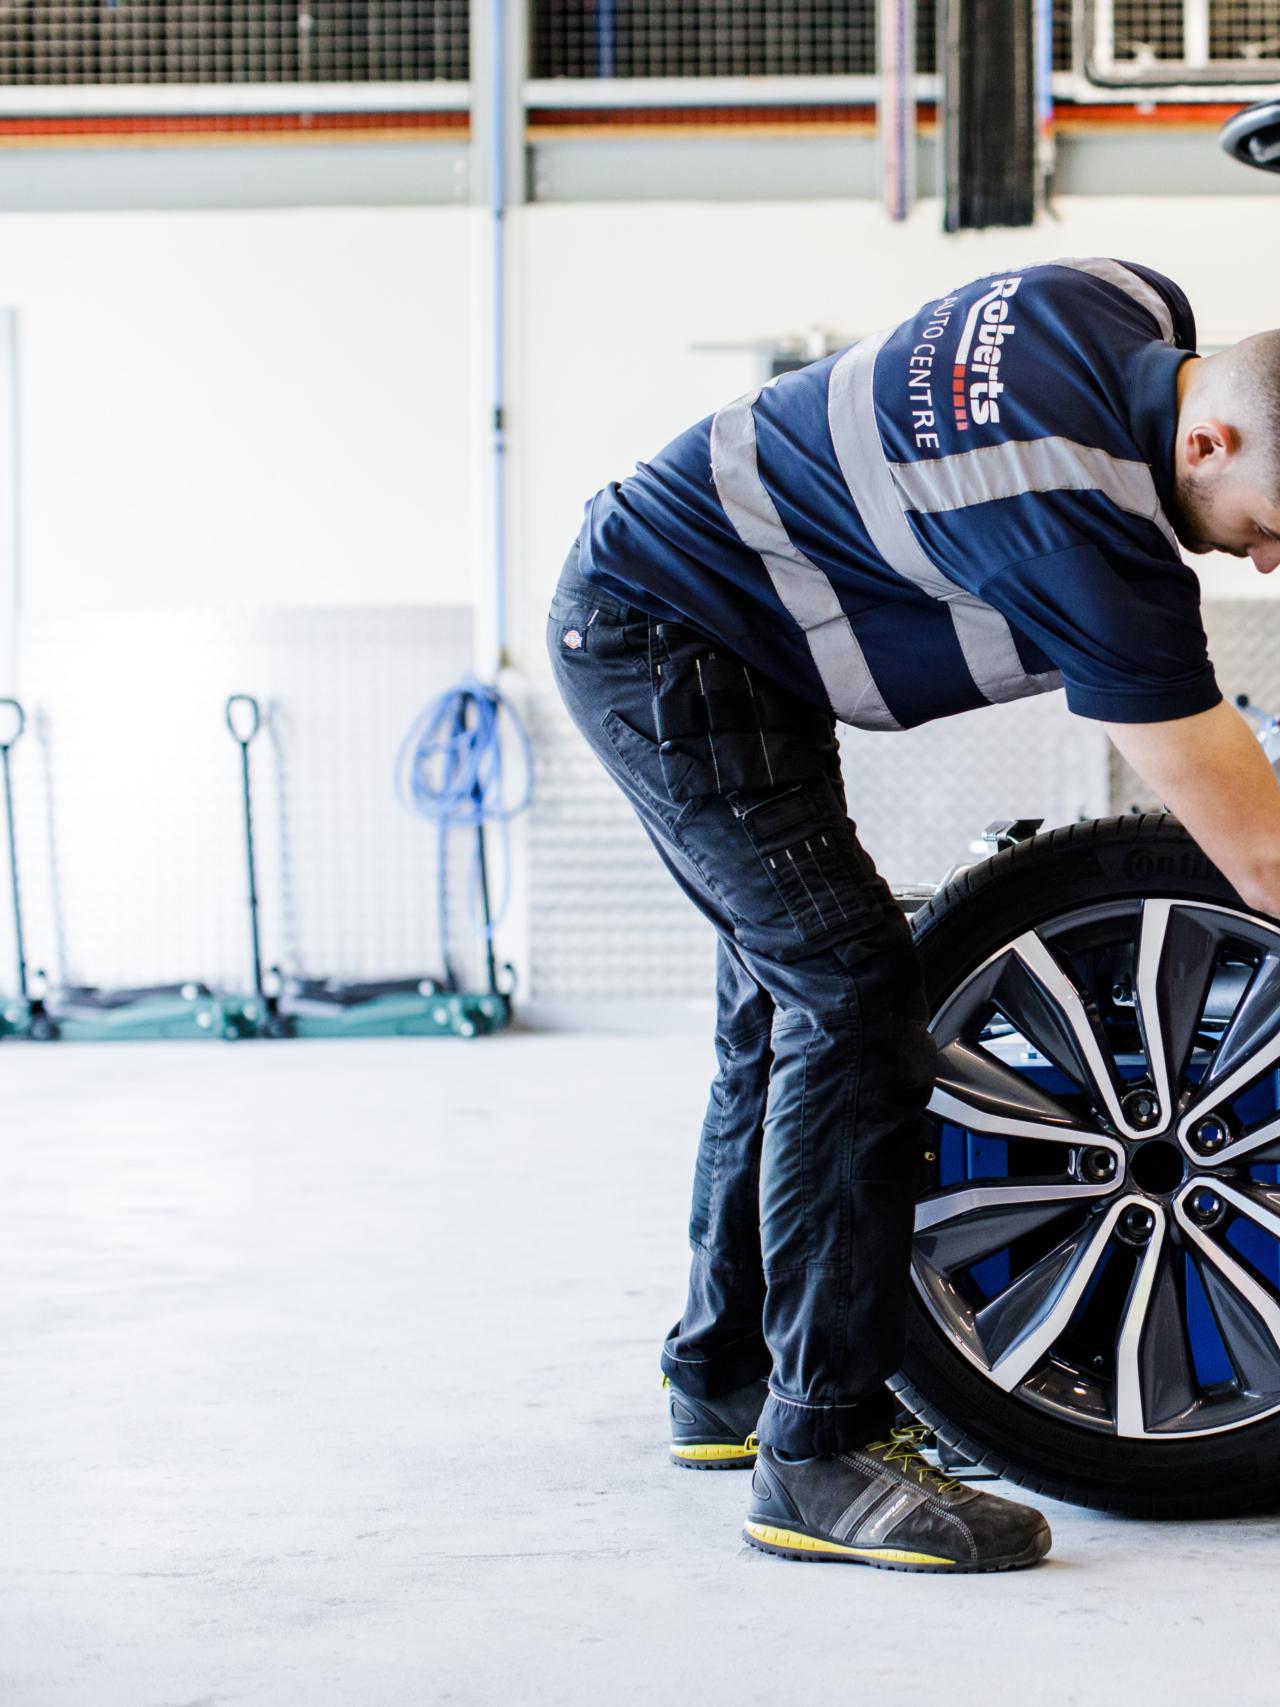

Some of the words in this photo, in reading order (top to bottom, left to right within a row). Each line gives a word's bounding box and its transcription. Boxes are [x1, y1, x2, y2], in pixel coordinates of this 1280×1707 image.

[922, 296, 960, 339] AUTO
[968, 276, 1023, 425] Roberts
[908, 343, 940, 449] CENTRE
